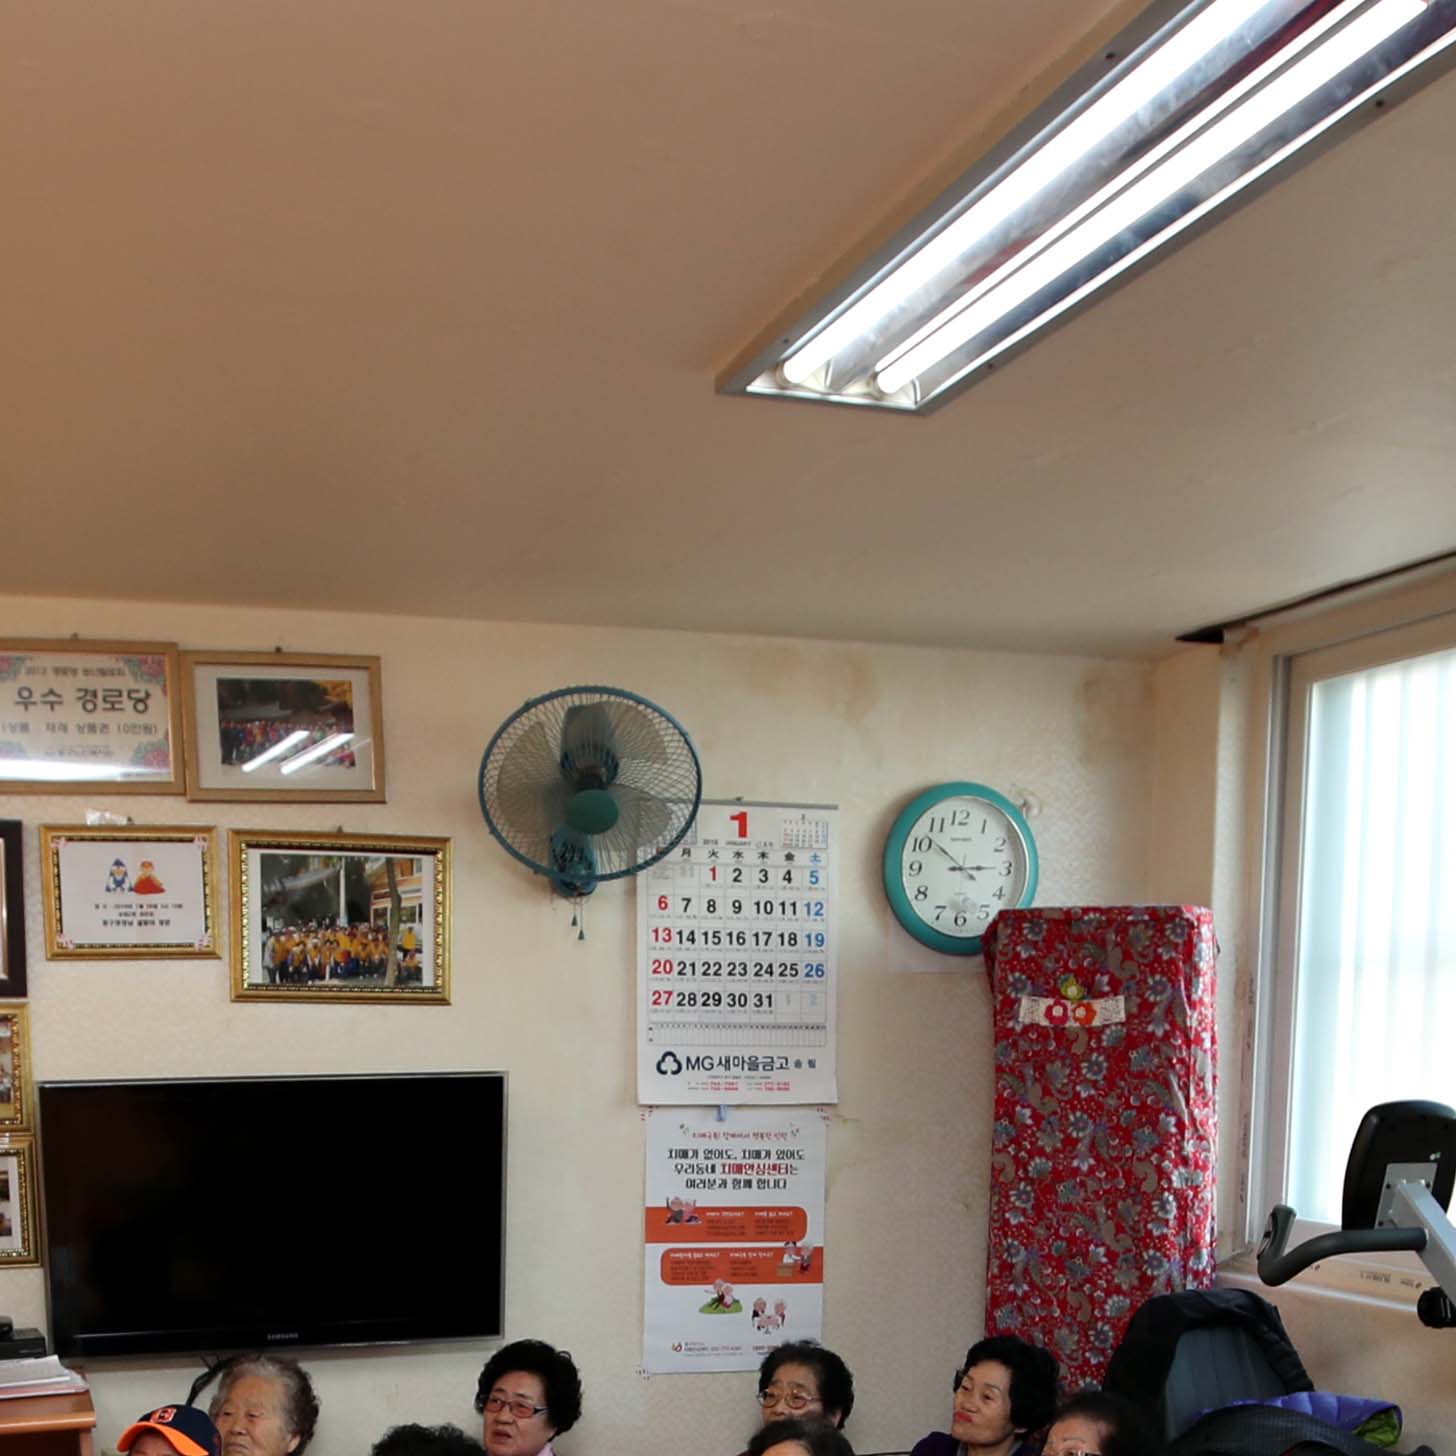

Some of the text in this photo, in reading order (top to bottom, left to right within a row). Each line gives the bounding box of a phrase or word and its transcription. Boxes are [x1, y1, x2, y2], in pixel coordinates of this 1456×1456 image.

[14, 687, 152, 714] 우수 경로당
[730, 812, 747, 838] 1
[929, 818, 945, 832] 11
[951, 810, 970, 826] 12
[981, 819, 986, 834] 1
[912, 836, 933, 852] 10
[994, 837, 1006, 852] 2
[710, 866, 818, 885] 1 2 3 4 5
[909, 861, 922, 877] 9
[999, 861, 1012, 876] 3
[915, 885, 928, 901] 8
[992, 886, 1006, 900] 4
[658, 895, 823, 916] 6 7 8 9 10 11 12
[977, 905, 990, 920] 5
[934, 906, 946, 921] 7
[954, 912, 967, 926] 6
[653, 928, 824, 947] 13 14 15 16 17 18 19
[652, 960, 824, 978] 20 21 22 23 24 25 26
[652, 991, 673, 1005] 27
[677, 992, 697, 1007] 28
[701, 992, 722, 1007] 29
[727, 993, 747, 1007] 30
[754, 993, 772, 1008] 31
[686, 1056, 789, 1071] MG새마을금고
[668, 1149, 804, 1160] 치매가 없어도, 치매가 있어도
[675, 1163, 797, 1175] 우리동네 치매안심센터는
[686, 1178, 787, 1189] 여러분과 함께 합니다
